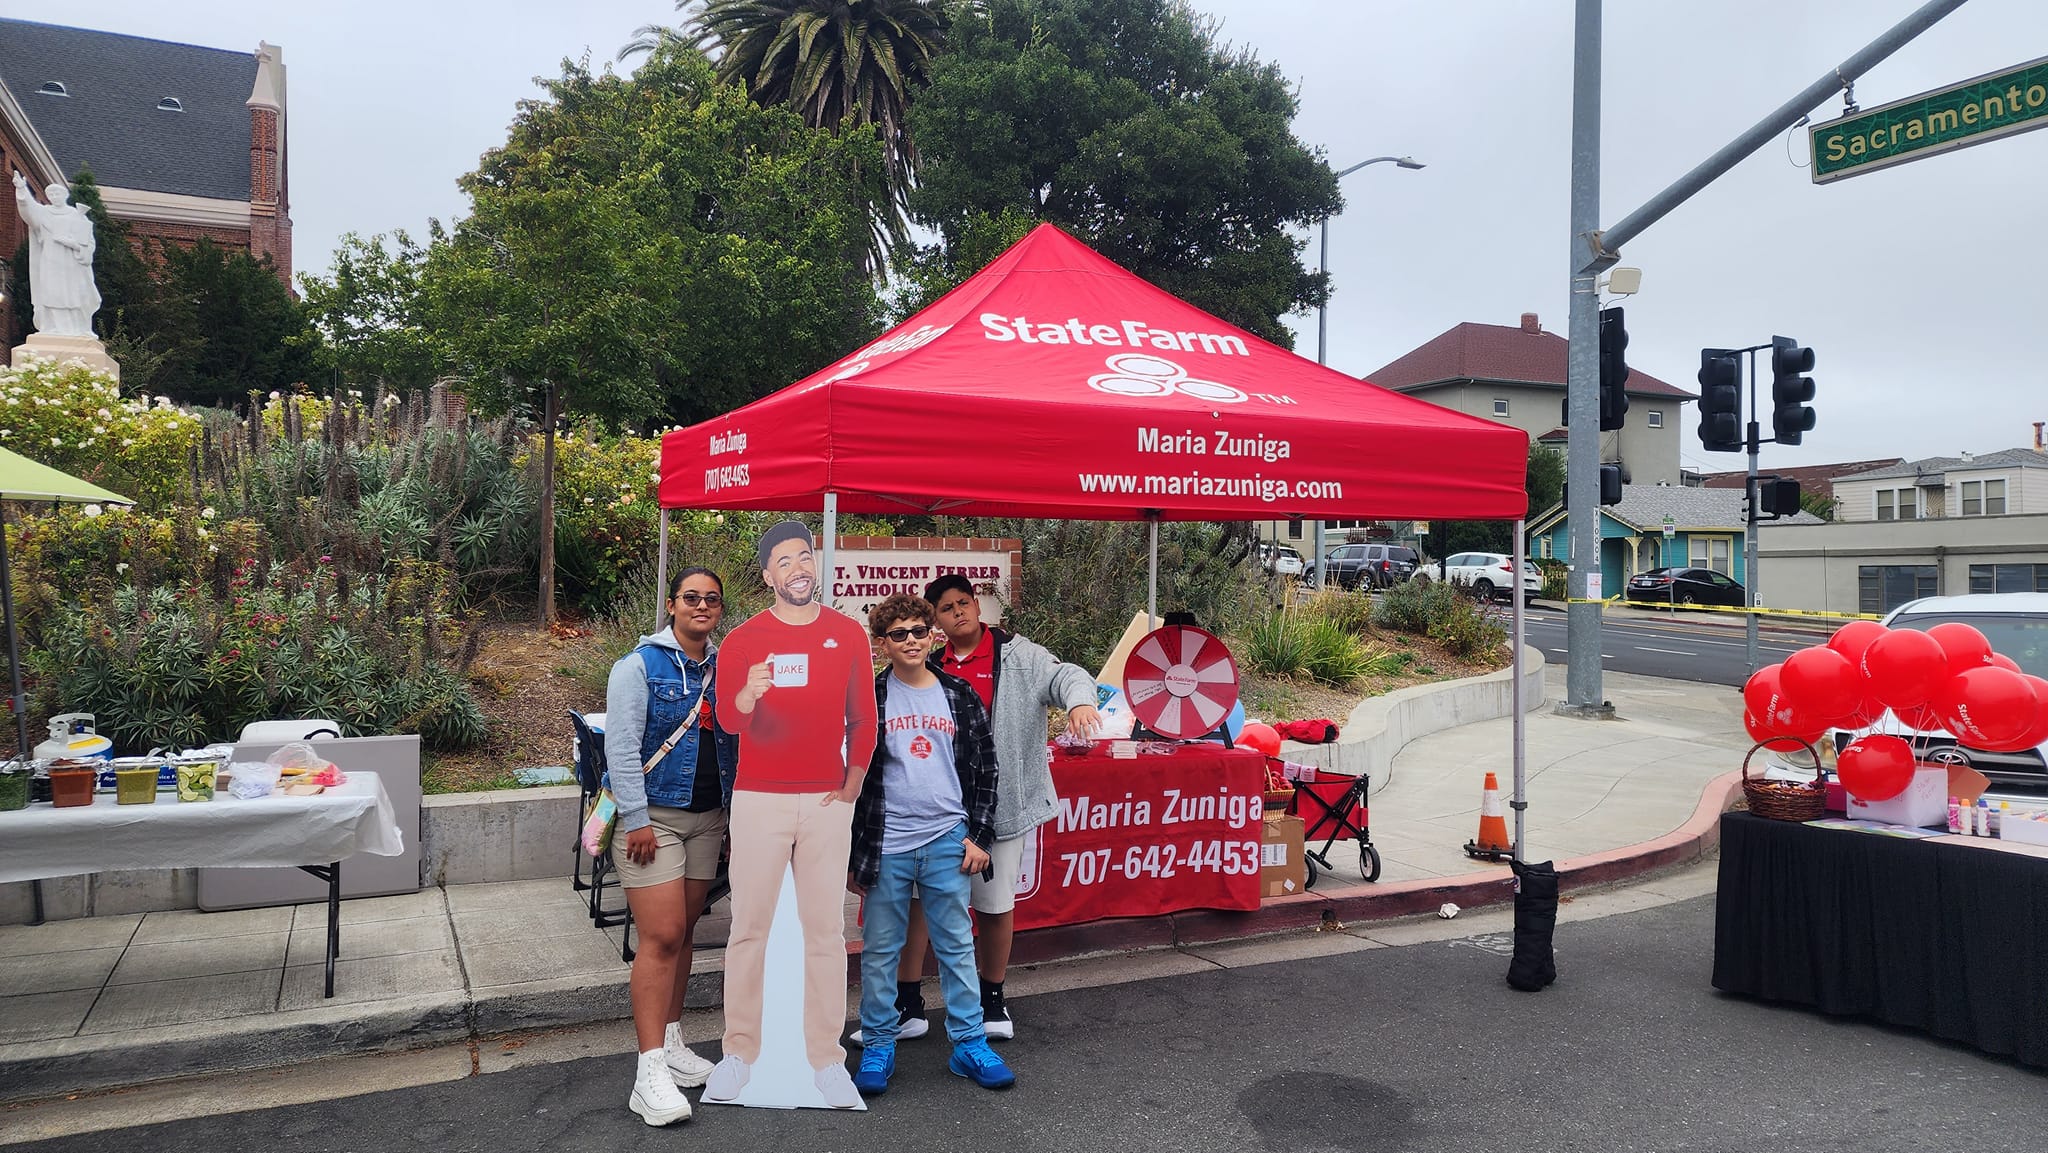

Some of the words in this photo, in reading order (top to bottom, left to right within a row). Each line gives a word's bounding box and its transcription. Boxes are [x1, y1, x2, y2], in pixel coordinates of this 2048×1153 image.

[1826, 84, 2047, 162] Sacramento
[1252, 393, 1298, 406] TM
[710, 432, 726, 456] Maria
[726, 428, 747, 455] Zuniga
[1137, 427, 1206, 456] Maria
[1214, 431, 1291, 463] Zuniga
[704, 467, 720, 495] (707)
[720, 463, 750, 488] 642-4453
[1079, 471, 1343, 502] www.mariazuniga.com
[834, 566, 851, 579] T.
[856, 565, 930, 579] VINCENT
[935, 565, 1000, 579] FERRER
[832, 583, 919, 597] CATHOLIC
[777, 664, 805, 675] JAKE
[884, 715, 919, 735] TATE
[1057, 792, 1151, 834] Maria
[1161, 787, 1262, 830] Zuniga
[1061, 840, 1260, 888] 707-642-4453
